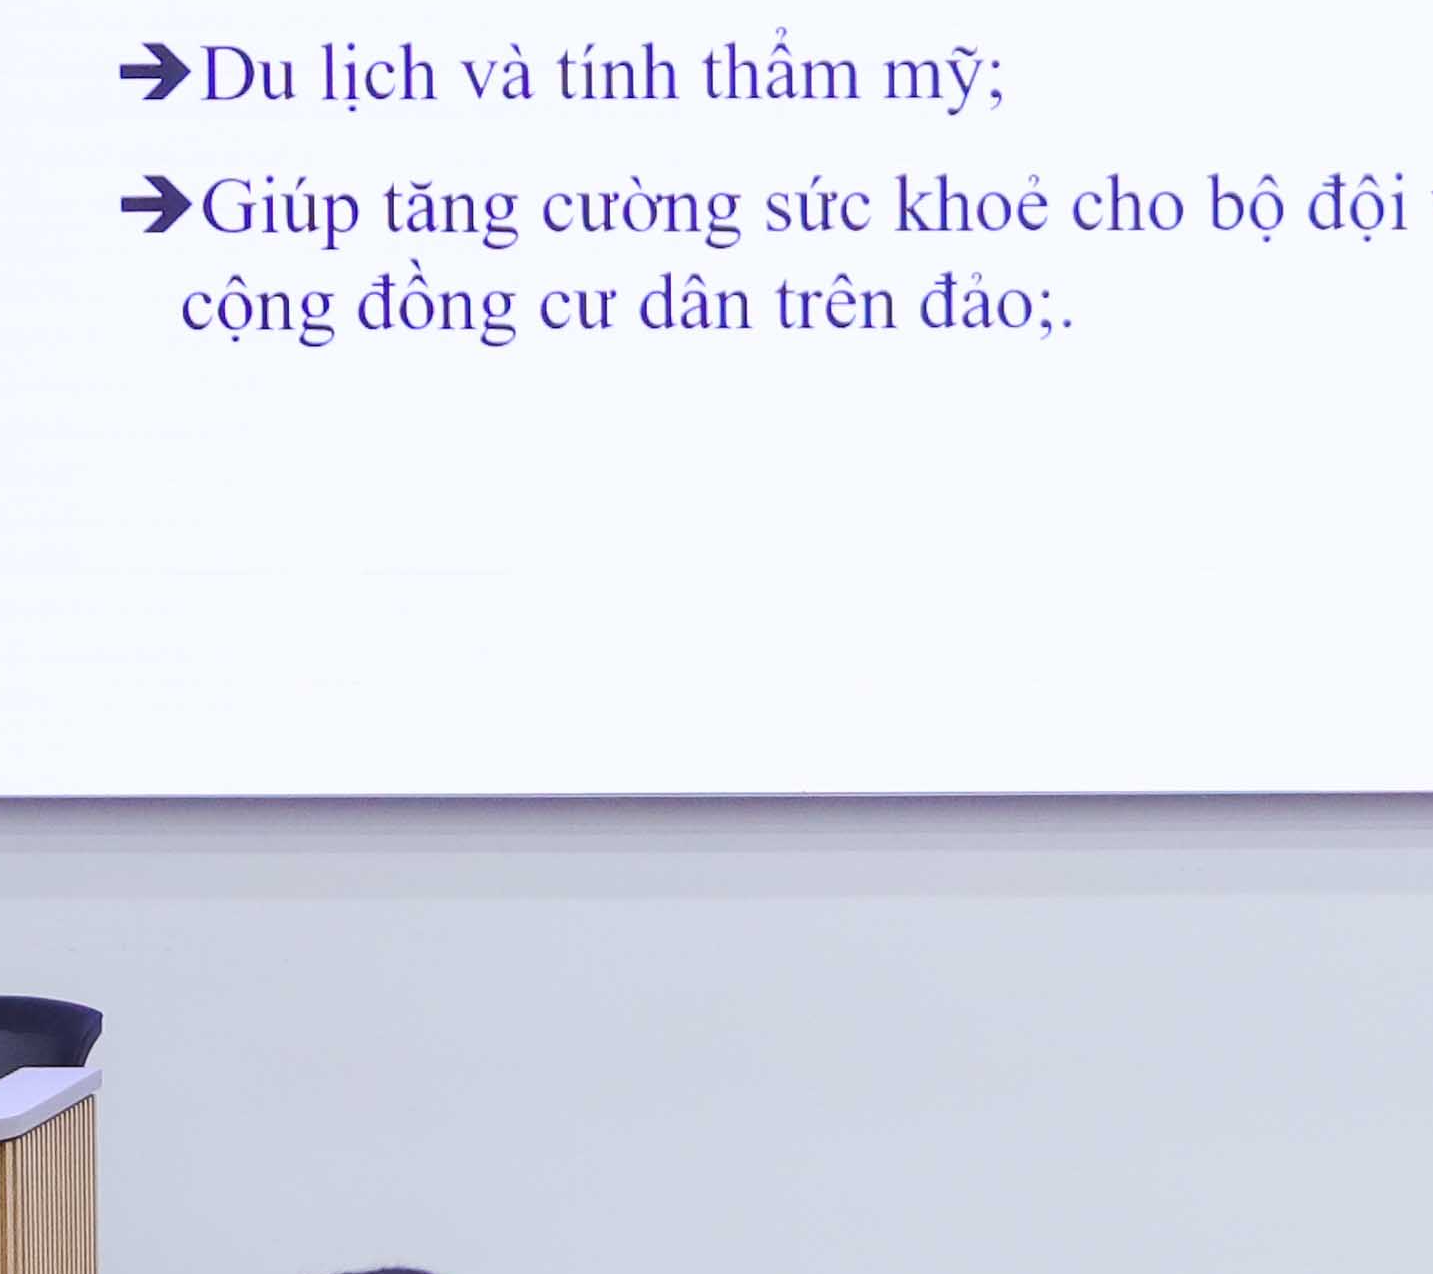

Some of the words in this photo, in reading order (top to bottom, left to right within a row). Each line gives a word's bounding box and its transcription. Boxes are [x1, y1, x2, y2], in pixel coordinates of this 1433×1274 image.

[201, 46, 297, 102] Du
[322, 42, 439, 114] lịch
[462, 43, 534, 101] và
[558, 42, 680, 101] tính
[703, 27, 861, 101] thẩm
[885, 46, 1004, 117] mỹ;
[203, 175, 361, 252] Giúp
[384, 182, 520, 252] tăng
[543, 176, 743, 251] cường
[766, 175, 872, 233] sức
[896, 174, 1049, 233] khoẻ
[1073, 173, 1185, 232] cho
[1208, 173, 1286, 244] bộ
[1308, 173, 1408, 244] đội
[183, 275, 337, 349] cộng
[358, 258, 518, 349] đồng
[540, 290, 618, 331] cư
[640, 272, 753, 331] dân
[776, 273, 898, 331] trên
[920, 271, 1073, 336] đảo;.
